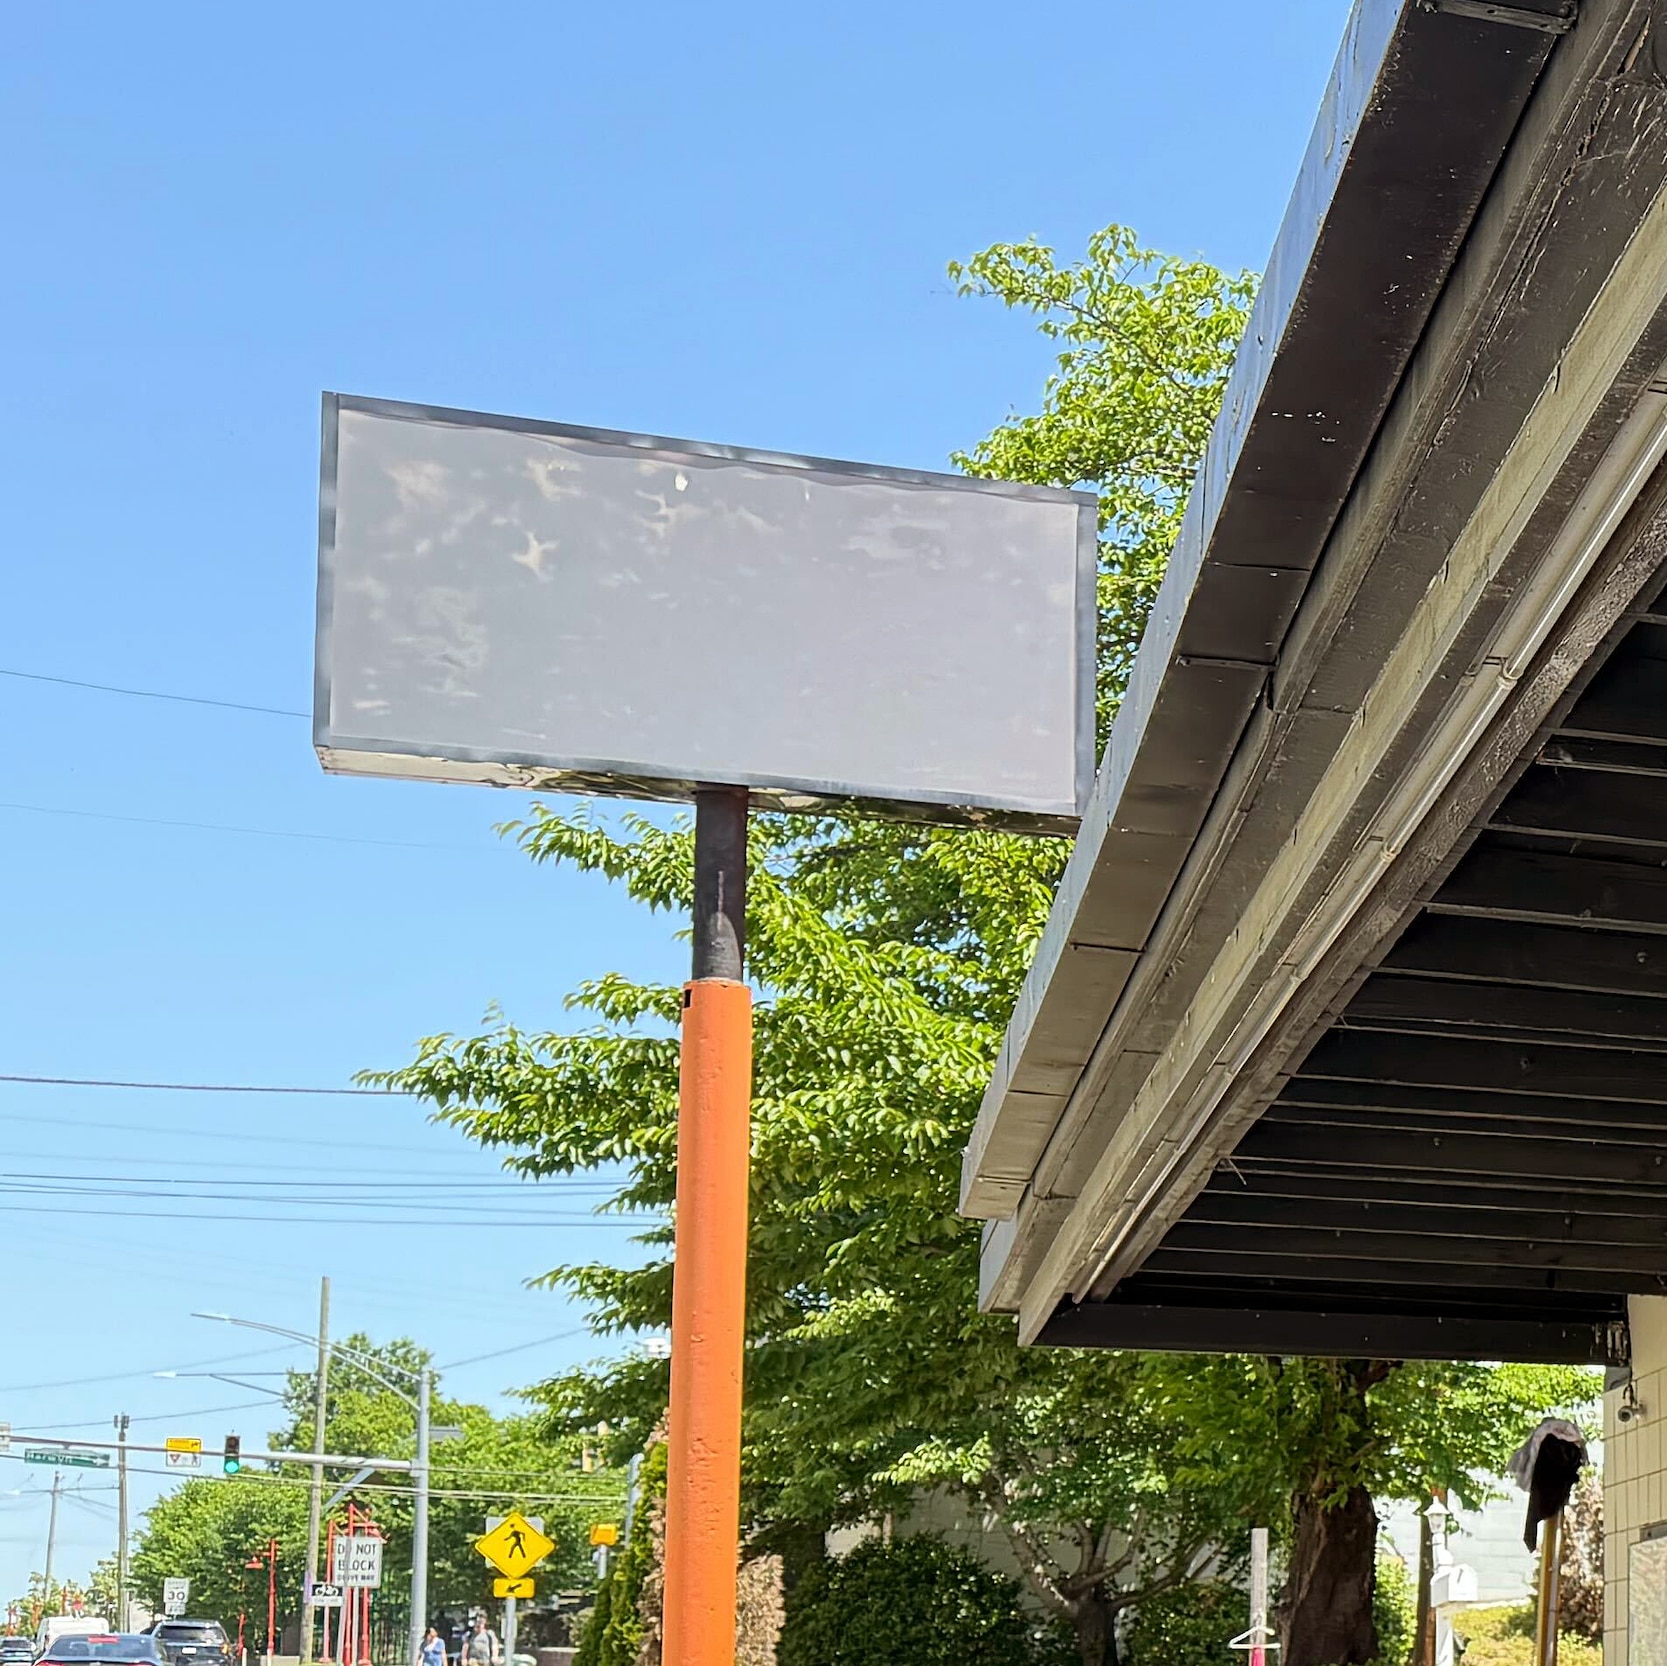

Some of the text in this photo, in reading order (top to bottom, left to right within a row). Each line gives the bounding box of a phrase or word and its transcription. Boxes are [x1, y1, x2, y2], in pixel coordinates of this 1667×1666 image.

[356, 1543, 376, 1555] NOT
[338, 1560, 375, 1571] BOCK
[168, 1590, 185, 1601] 30
